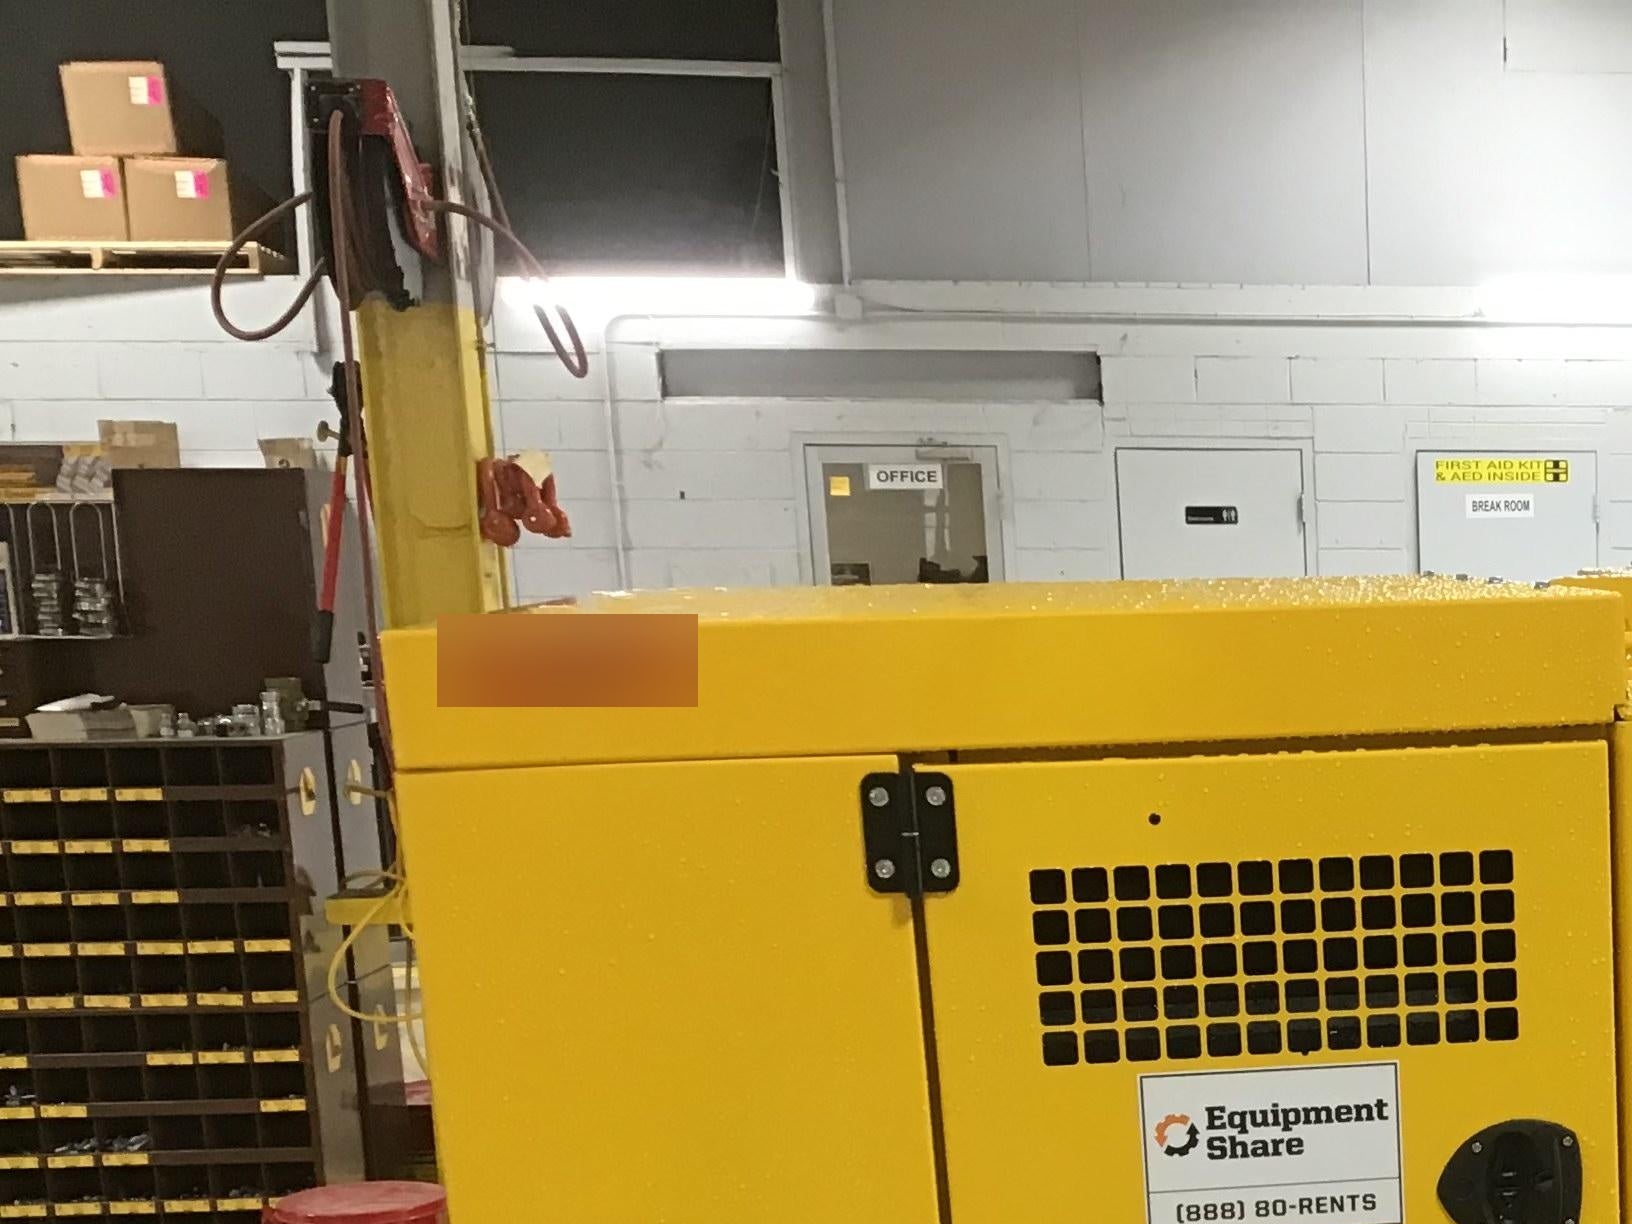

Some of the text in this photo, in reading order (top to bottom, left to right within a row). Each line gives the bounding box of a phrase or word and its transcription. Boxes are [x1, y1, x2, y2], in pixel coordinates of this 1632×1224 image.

[1435, 460, 1542, 470] FIRST AID KIT
[876, 470, 938, 483] OFFICE
[1435, 471, 1541, 481] & AED INSIDE
[1471, 499, 1531, 513] BREAK ROOM
[1205, 1097, 1389, 1133] Equipment
[1206, 1133, 1305, 1161] Share
[1175, 1192, 1378, 1224] (888) 80-RENTS
